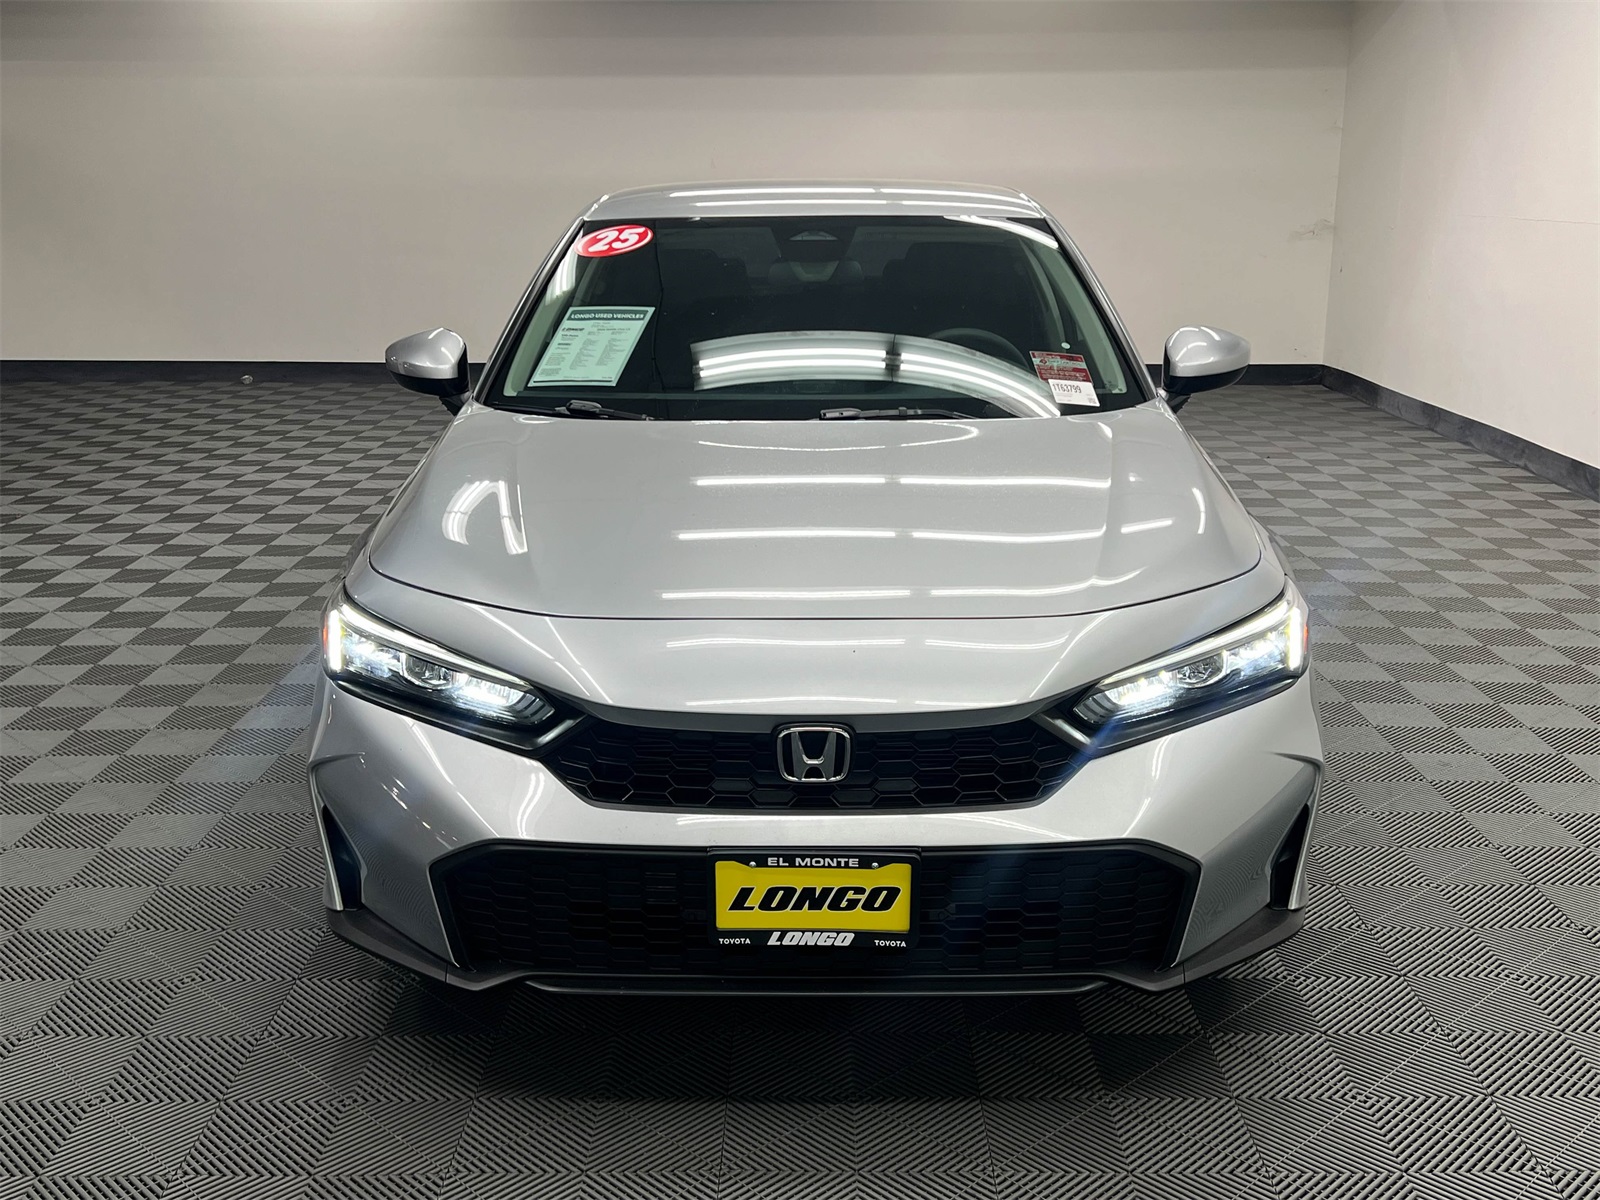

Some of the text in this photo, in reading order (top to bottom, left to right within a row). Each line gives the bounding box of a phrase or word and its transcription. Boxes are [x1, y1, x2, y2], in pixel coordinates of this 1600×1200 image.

[588, 227, 646, 253] 25
[767, 857, 859, 868] EL MONTE
[727, 885, 902, 913] LONGO
[767, 931, 855, 946] LONGO
[874, 939, 907, 948] TOYOTA
